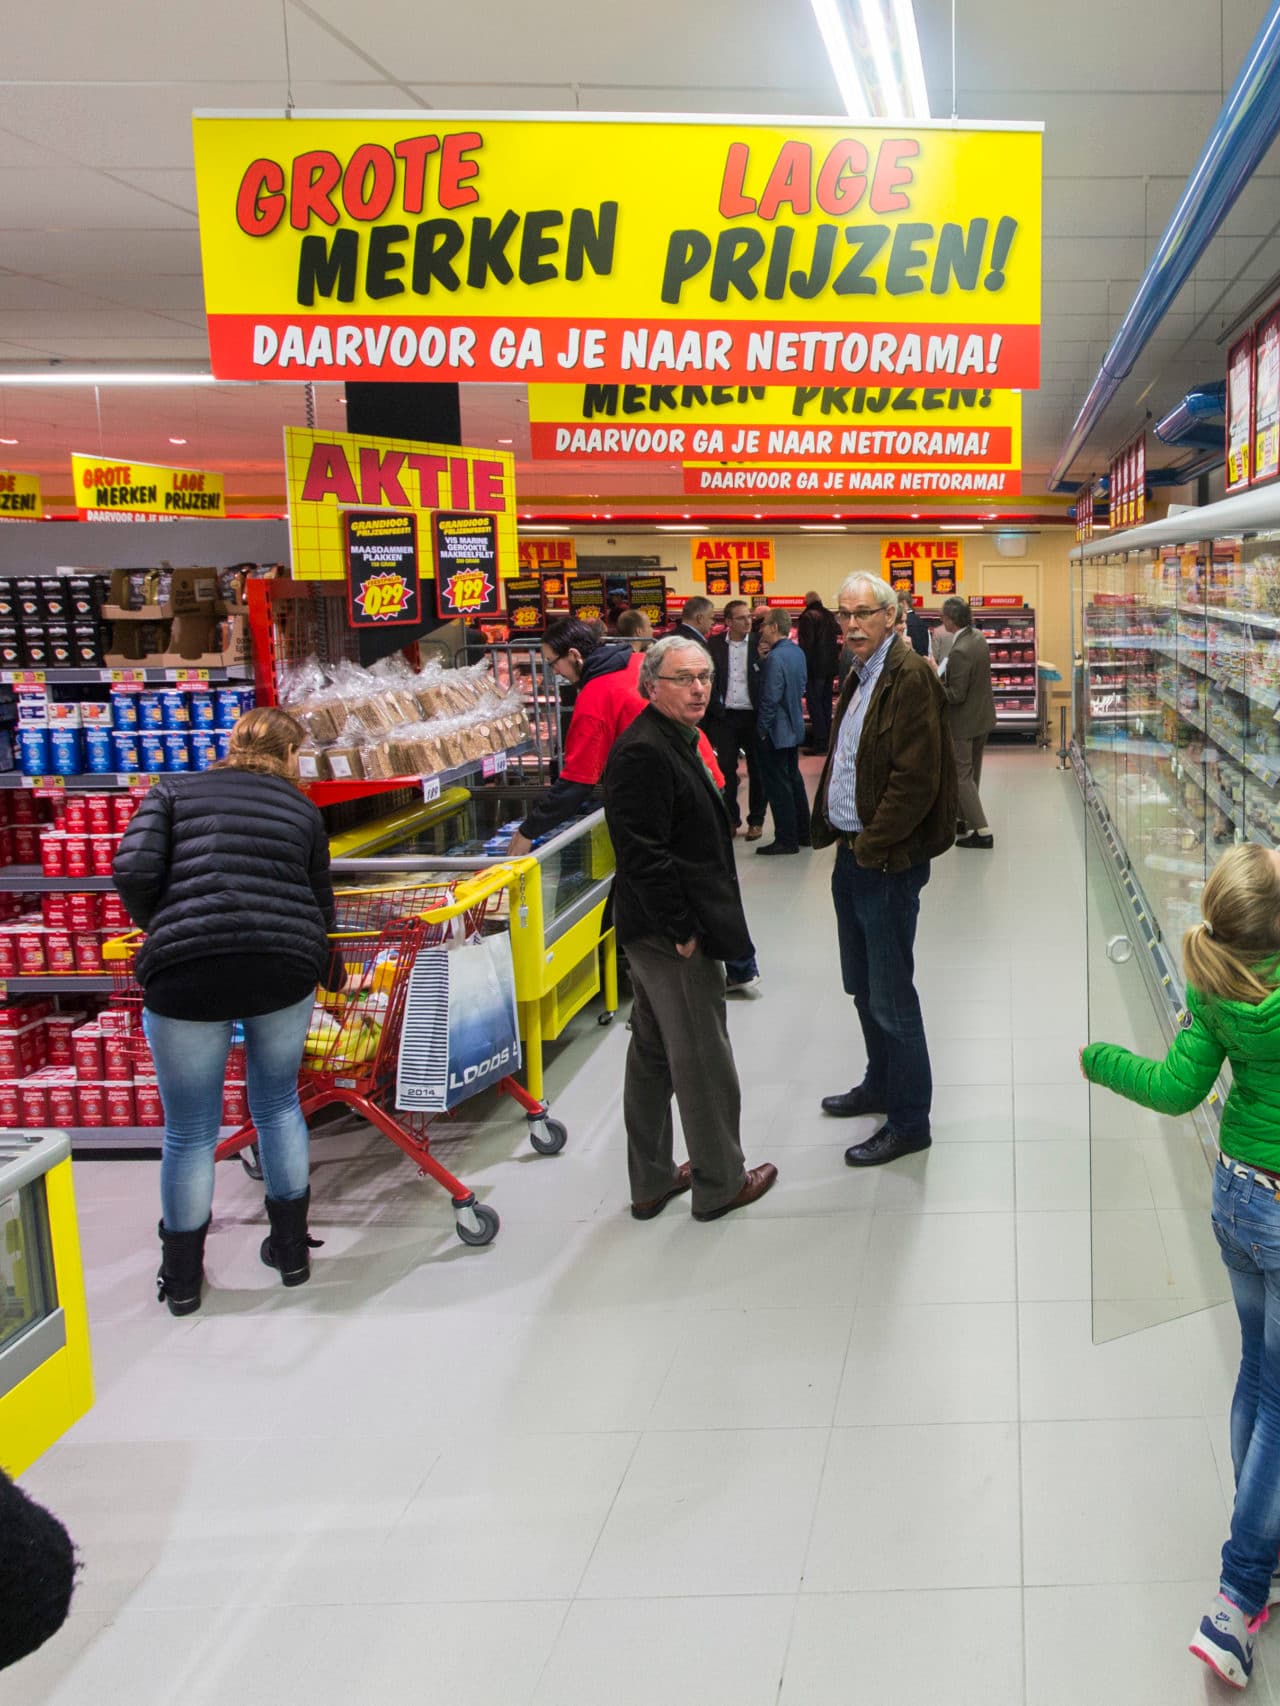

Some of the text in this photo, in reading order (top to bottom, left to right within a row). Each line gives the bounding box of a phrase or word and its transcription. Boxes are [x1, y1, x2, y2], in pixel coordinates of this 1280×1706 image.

[236, 131, 484, 238] GROTE
[719, 138, 923, 221] LAGE
[296, 200, 620, 307] MERKEN
[660, 216, 1018, 305] PRIJZEN!
[253, 323, 1002, 375] DAARVOOR GA JE NAAR NETTORAMA!
[555, 428, 989, 456] DAARVOOR GA JE NAAR NETTORAMA!
[83, 466, 131, 489] GROTE
[172, 473, 205, 492] LAGE
[300, 442, 507, 512] AKTIE
[700, 472, 1005, 491] DAARVOOR GA JE NAAR NETTORAMA!
[96, 485, 157, 506] MERKEN
[164, 492, 220, 510] PRIJZEN!
[351, 518, 409, 531] GRANDIOOS
[439, 518, 490, 529] GRANDIOOS
[350, 545, 414, 554] MAASDAMMER
[363, 553, 402, 561] PLAKKEN
[519, 542, 571, 560] KTIE
[696, 541, 770, 559] AKTIE
[885, 541, 958, 559] AKTIE
[449, 1053, 510, 1089] LOODS
[407, 1088, 435, 1096] 2014
